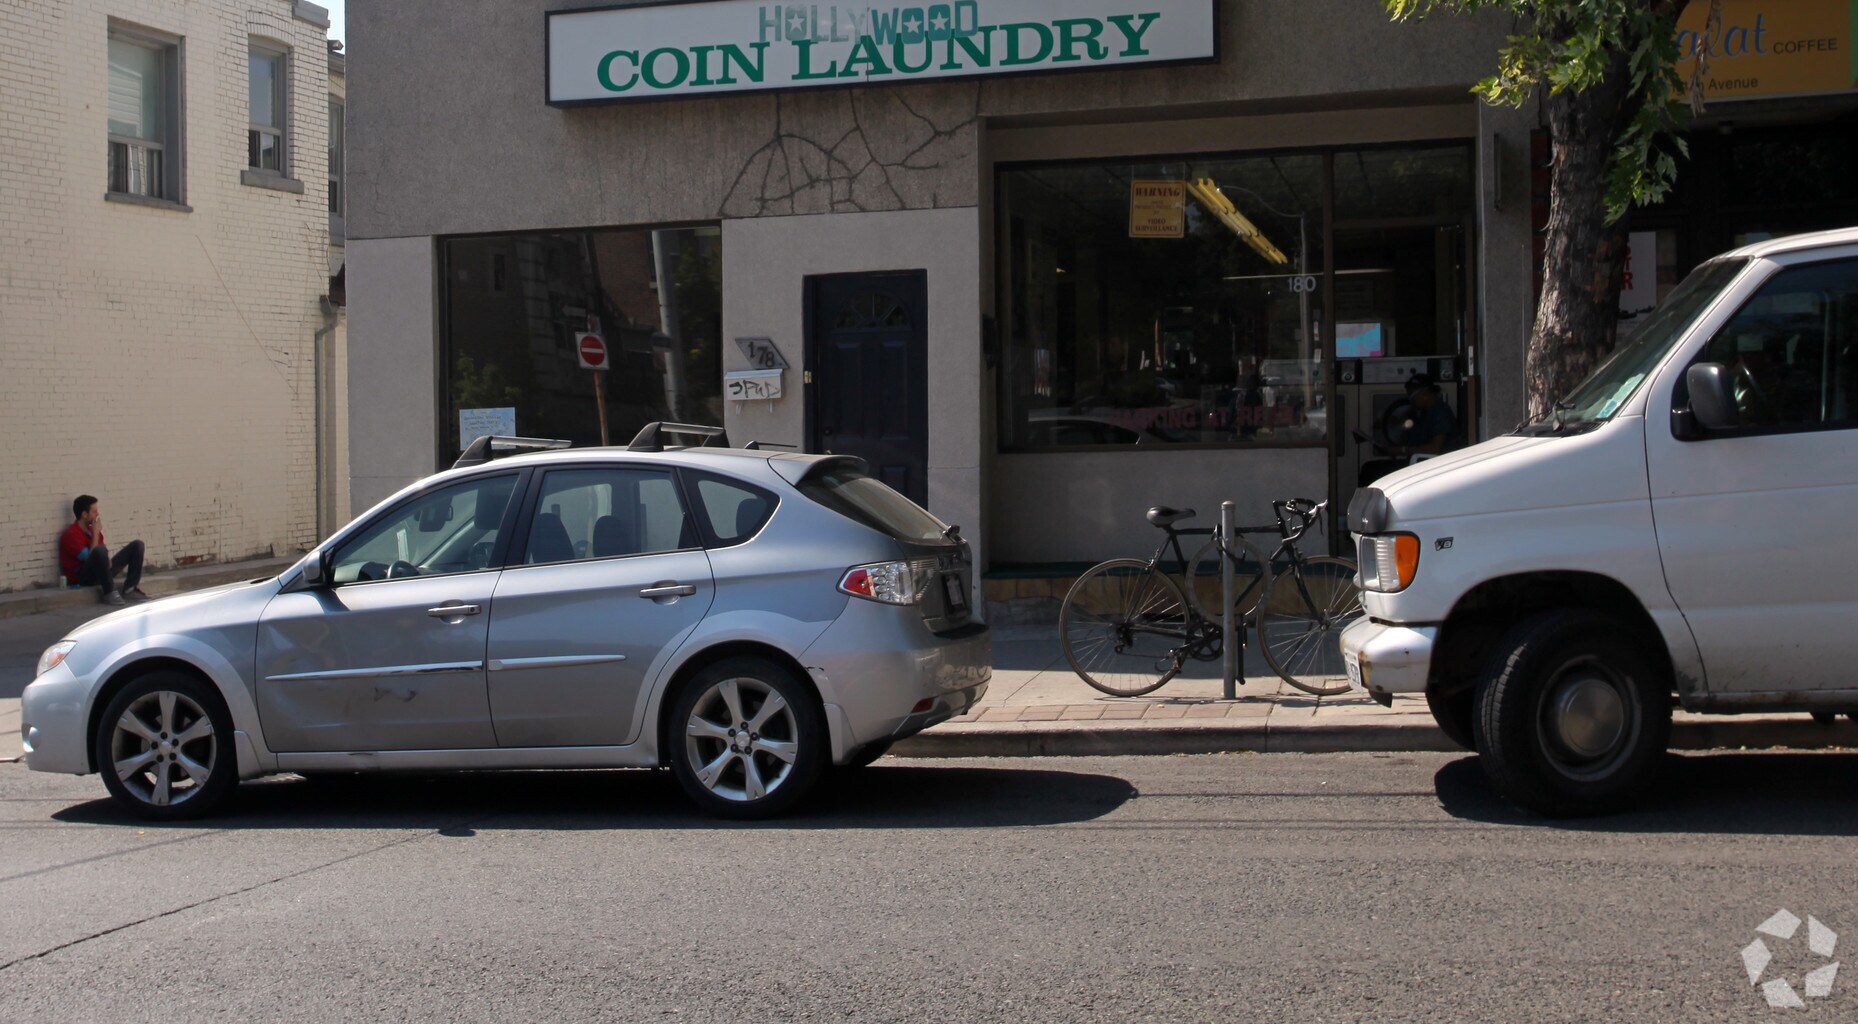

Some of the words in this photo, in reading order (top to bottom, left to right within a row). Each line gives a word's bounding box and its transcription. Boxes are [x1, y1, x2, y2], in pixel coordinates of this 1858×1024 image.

[759, 0, 977, 45] HOLLYWOOD
[1675, 13, 1768, 61] alat
[1773, 38, 1838, 54] COFFEE
[597, 42, 767, 92] COIN
[791, 12, 1160, 80] LAUNDRY
[1708, 78, 1758, 90] Avenue
[1136, 187, 1180, 197] WARNING
[1288, 276, 1317, 293] 180
[748, 341, 775, 367] 178
